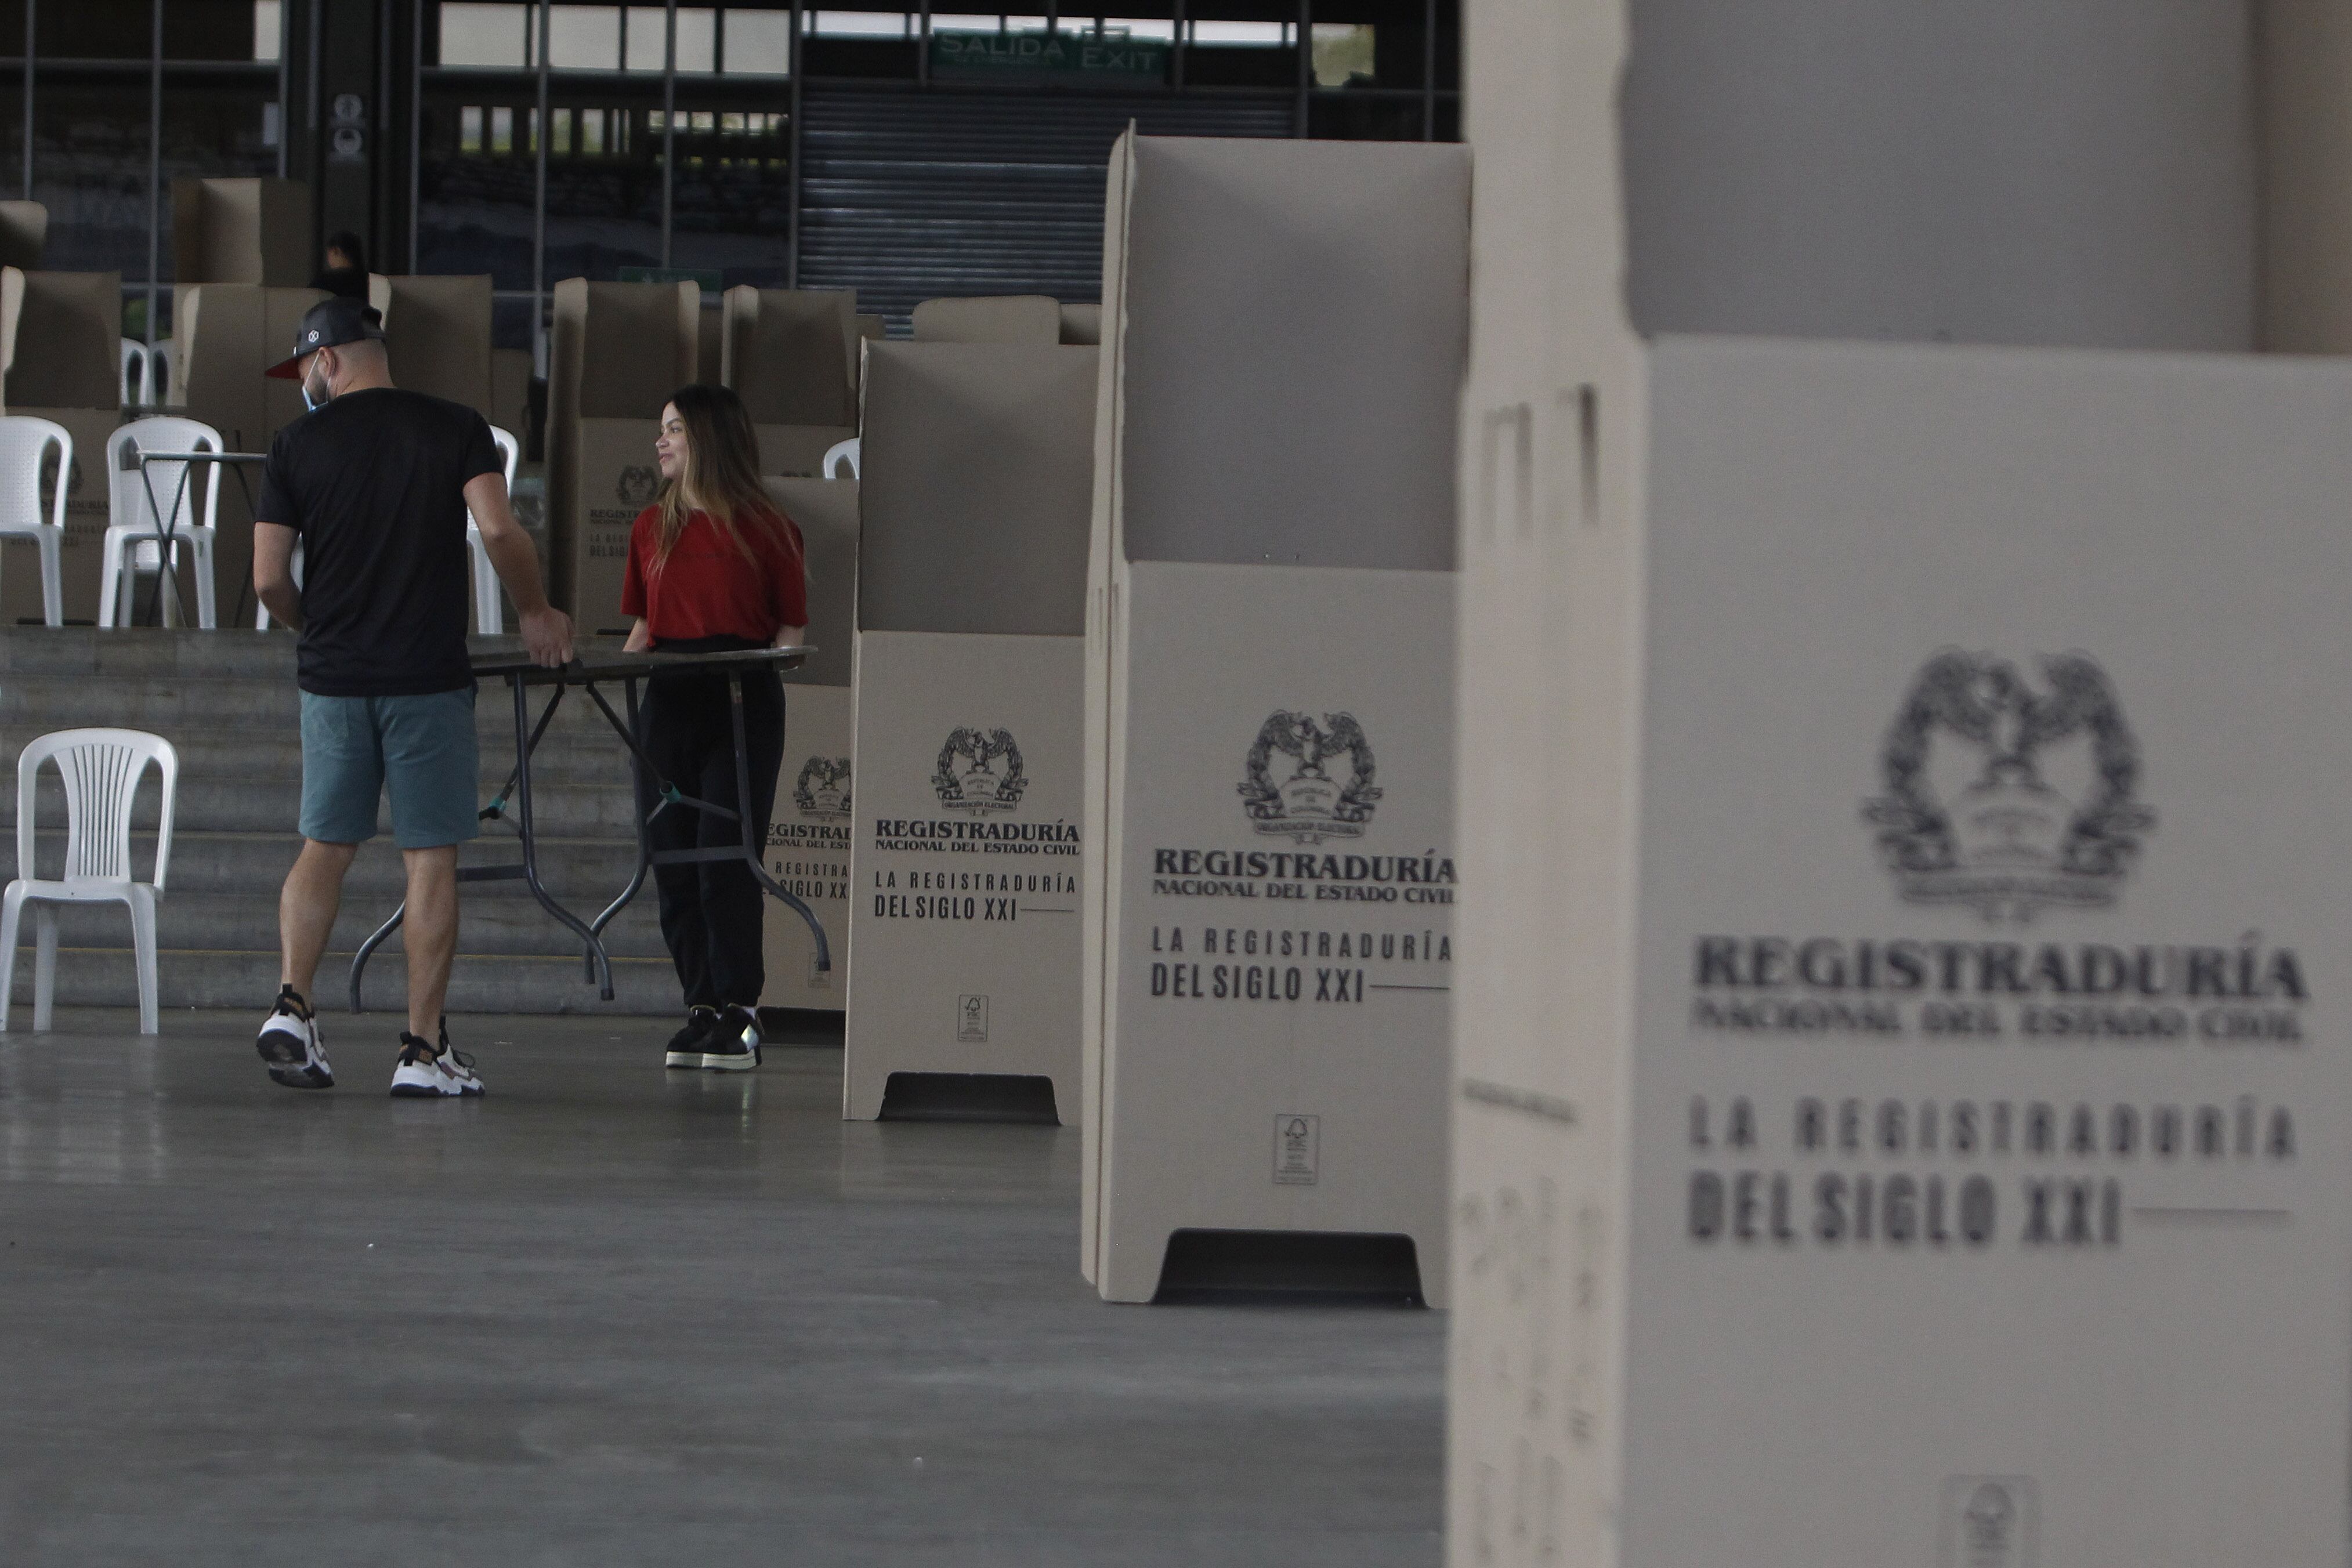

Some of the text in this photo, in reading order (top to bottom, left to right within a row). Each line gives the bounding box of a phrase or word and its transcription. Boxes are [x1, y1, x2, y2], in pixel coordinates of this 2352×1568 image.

[940, 35, 1157, 71] SALIDA EXIT
[806, 839, 826, 848] DEL
[875, 818, 1080, 842] REGISTRADURÍA
[875, 839, 1080, 855] NACIONAL DEL ESTADO CIVIL
[875, 871, 1076, 893] LA REGISTRADURÍA
[1154, 847, 1459, 885] REGISTRADURÍA
[780, 879, 823, 898] SIGLO
[1153, 879, 1454, 904] NACIONAL DEL ESTADO CIVIL
[874, 894, 1016, 921] DEL SIGLO XXI
[1152, 926, 1452, 960] LA REGISTRADURÍA
[1151, 962, 1363, 1002] DEL SIGLO XXI
[1693, 930, 2310, 1002] REGISTRADURÍA
[1689, 997, 2303, 1041] NACIONAL DEL ESTADO CIVIL
[1688, 1092, 2296, 1157] LA REGISTRADURÍA
[1687, 1169, 2122, 1247] DEL SIGLO XXI
